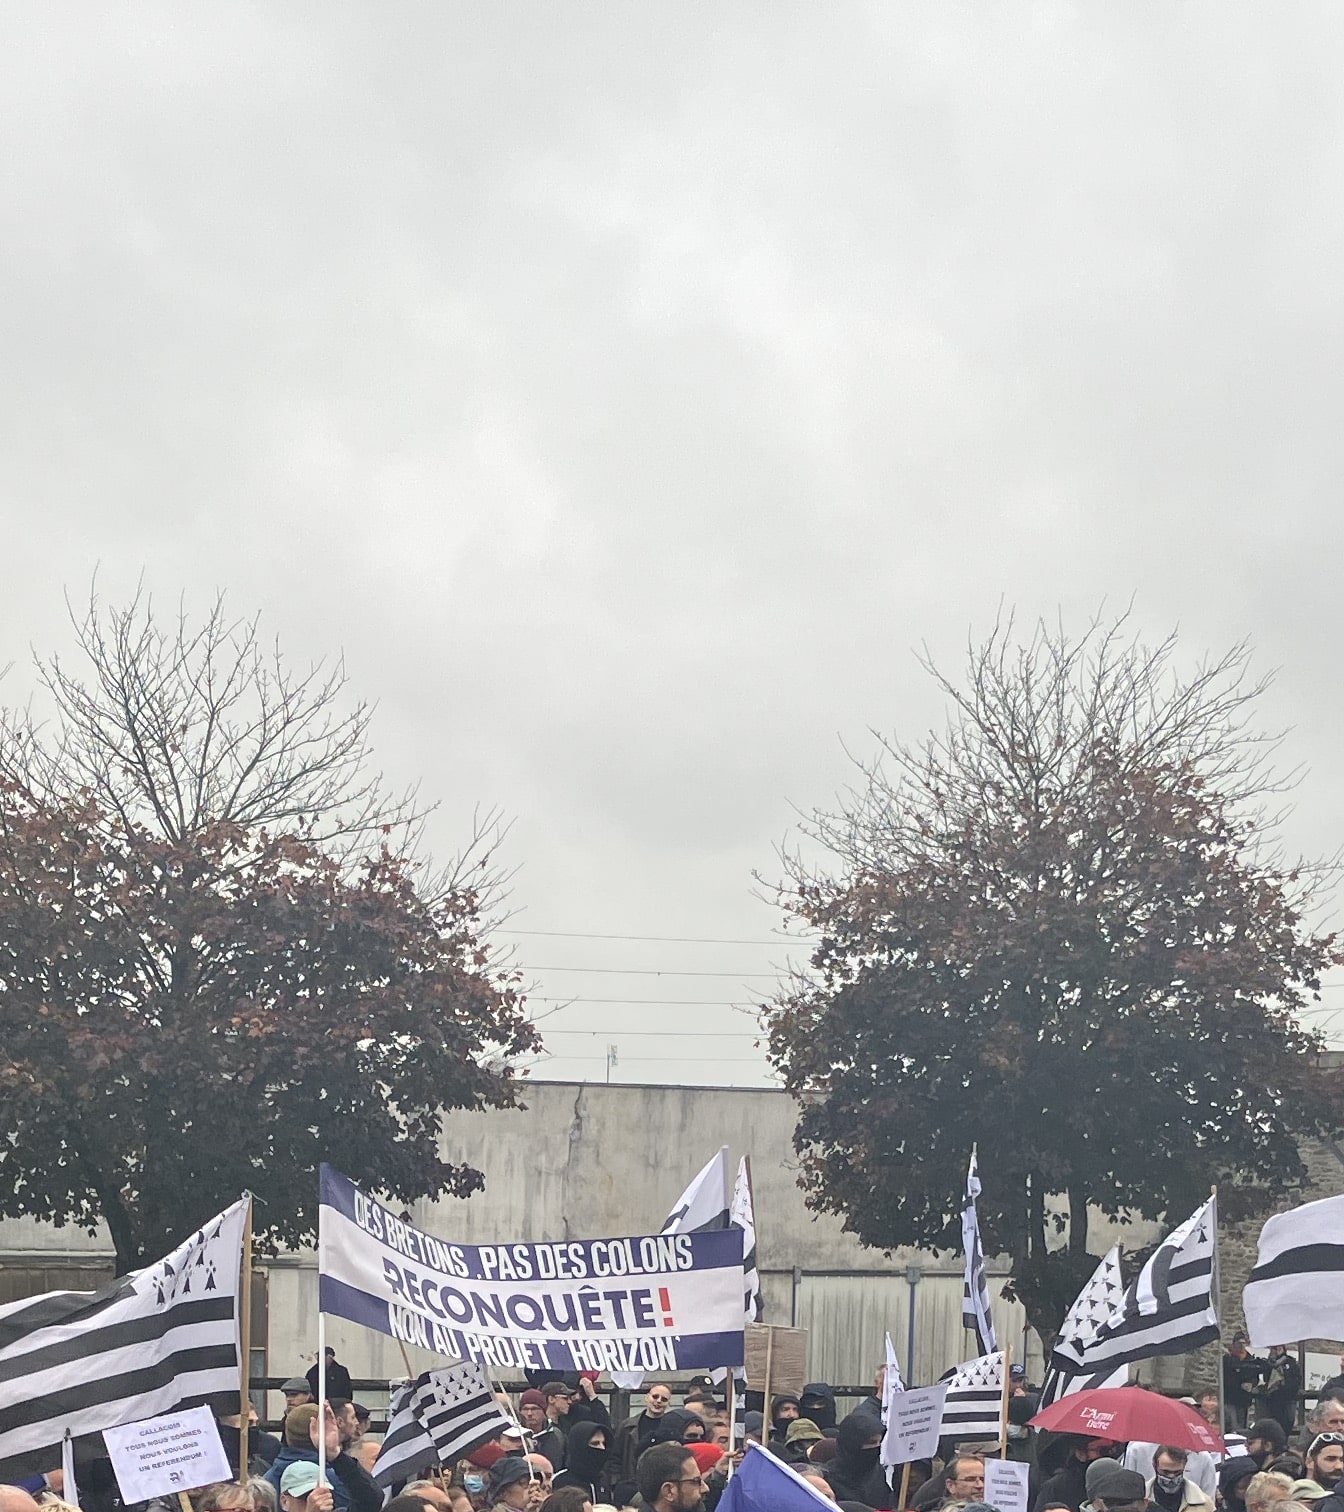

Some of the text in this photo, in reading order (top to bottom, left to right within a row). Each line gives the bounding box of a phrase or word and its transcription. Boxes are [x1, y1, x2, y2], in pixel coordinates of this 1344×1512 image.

[354, 1189, 384, 1240] DES
[384, 1211, 470, 1278] BRETONS
[535, 1242, 587, 1279] DES
[591, 1234, 694, 1277] COLONS
[388, 1302, 431, 1350] NON
[432, 1322, 462, 1359] AU
[463, 1331, 552, 1370] PROJET
[140, 1450, 162, 1460] NOUS
[148, 1438, 169, 1447] NOUS
